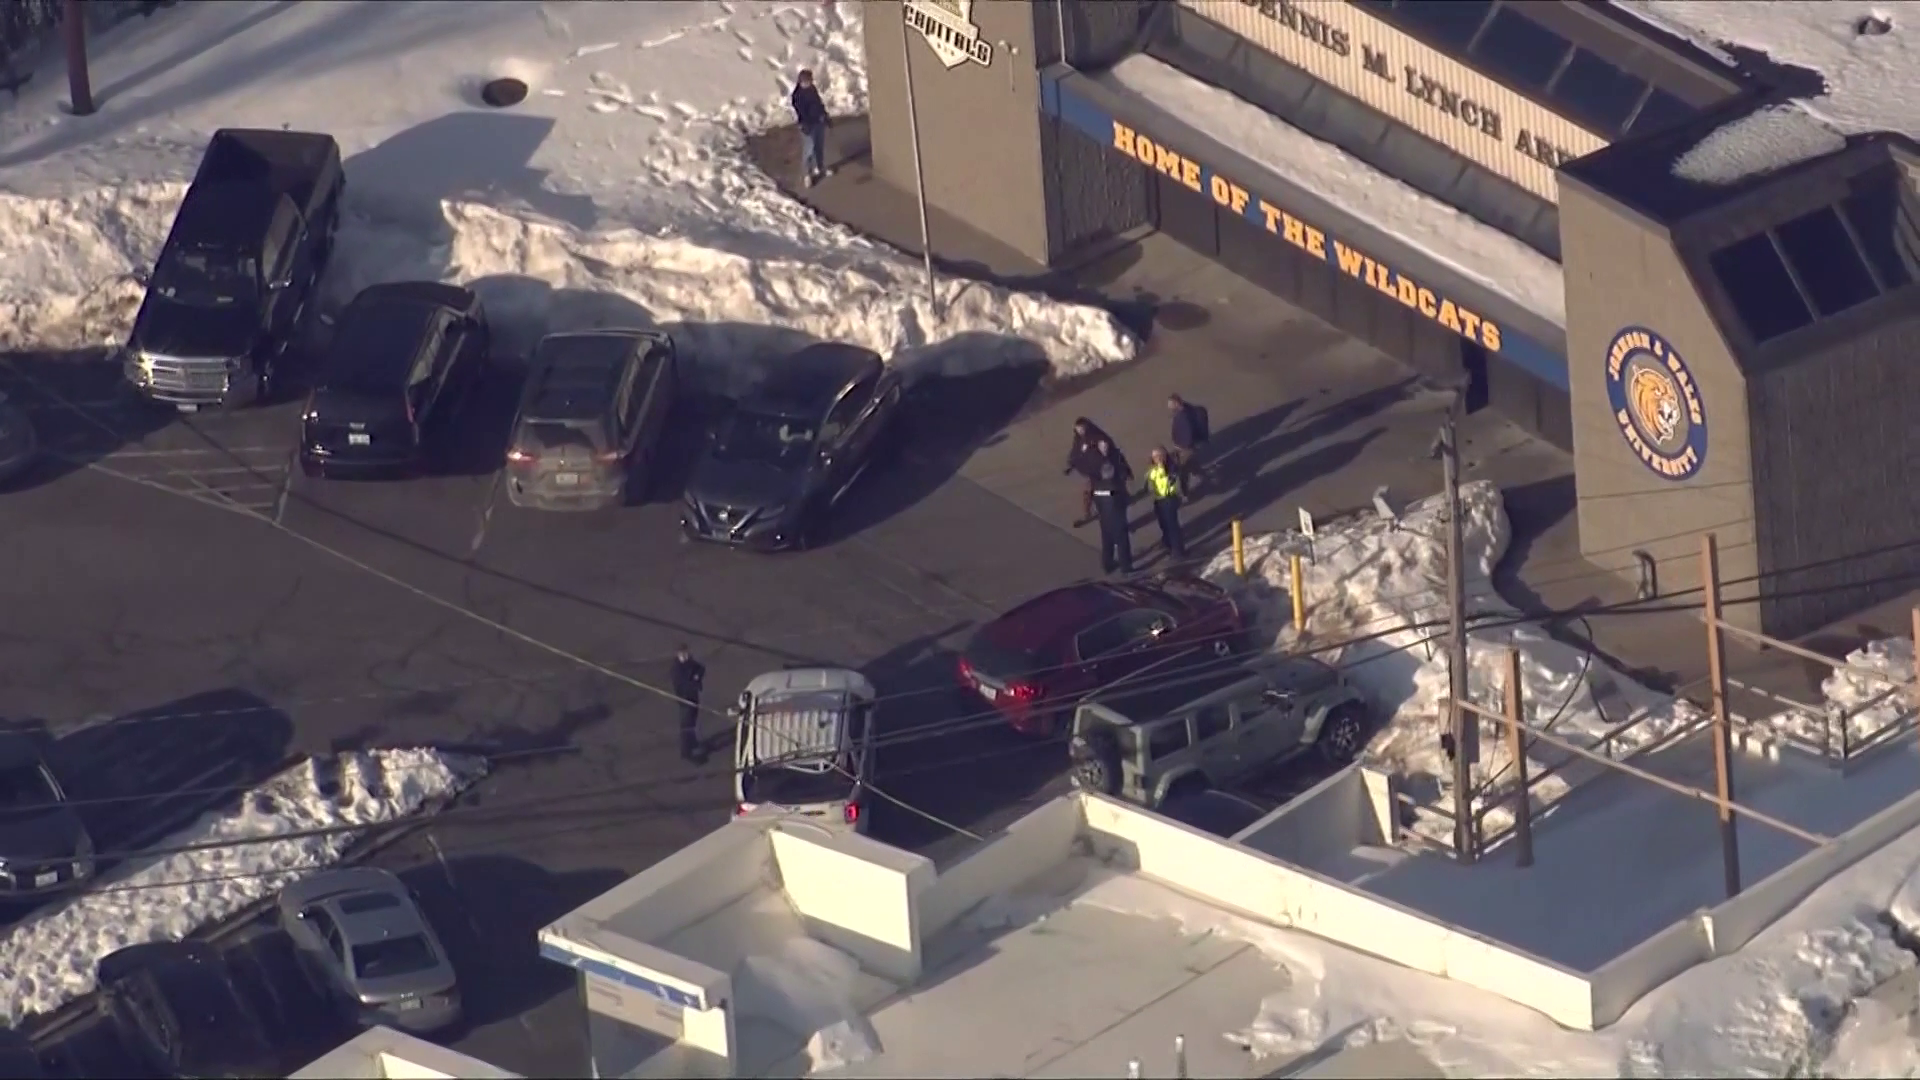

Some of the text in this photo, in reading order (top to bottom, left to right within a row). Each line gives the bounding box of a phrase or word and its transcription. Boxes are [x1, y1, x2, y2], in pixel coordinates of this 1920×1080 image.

[1240, 0, 1350, 56] ENNIS
[1362, 44, 1396, 83] M.
[1404, 65, 1503, 141] LYNCH
[1113, 120, 1502, 353] HOME OF THE WILDCATS
